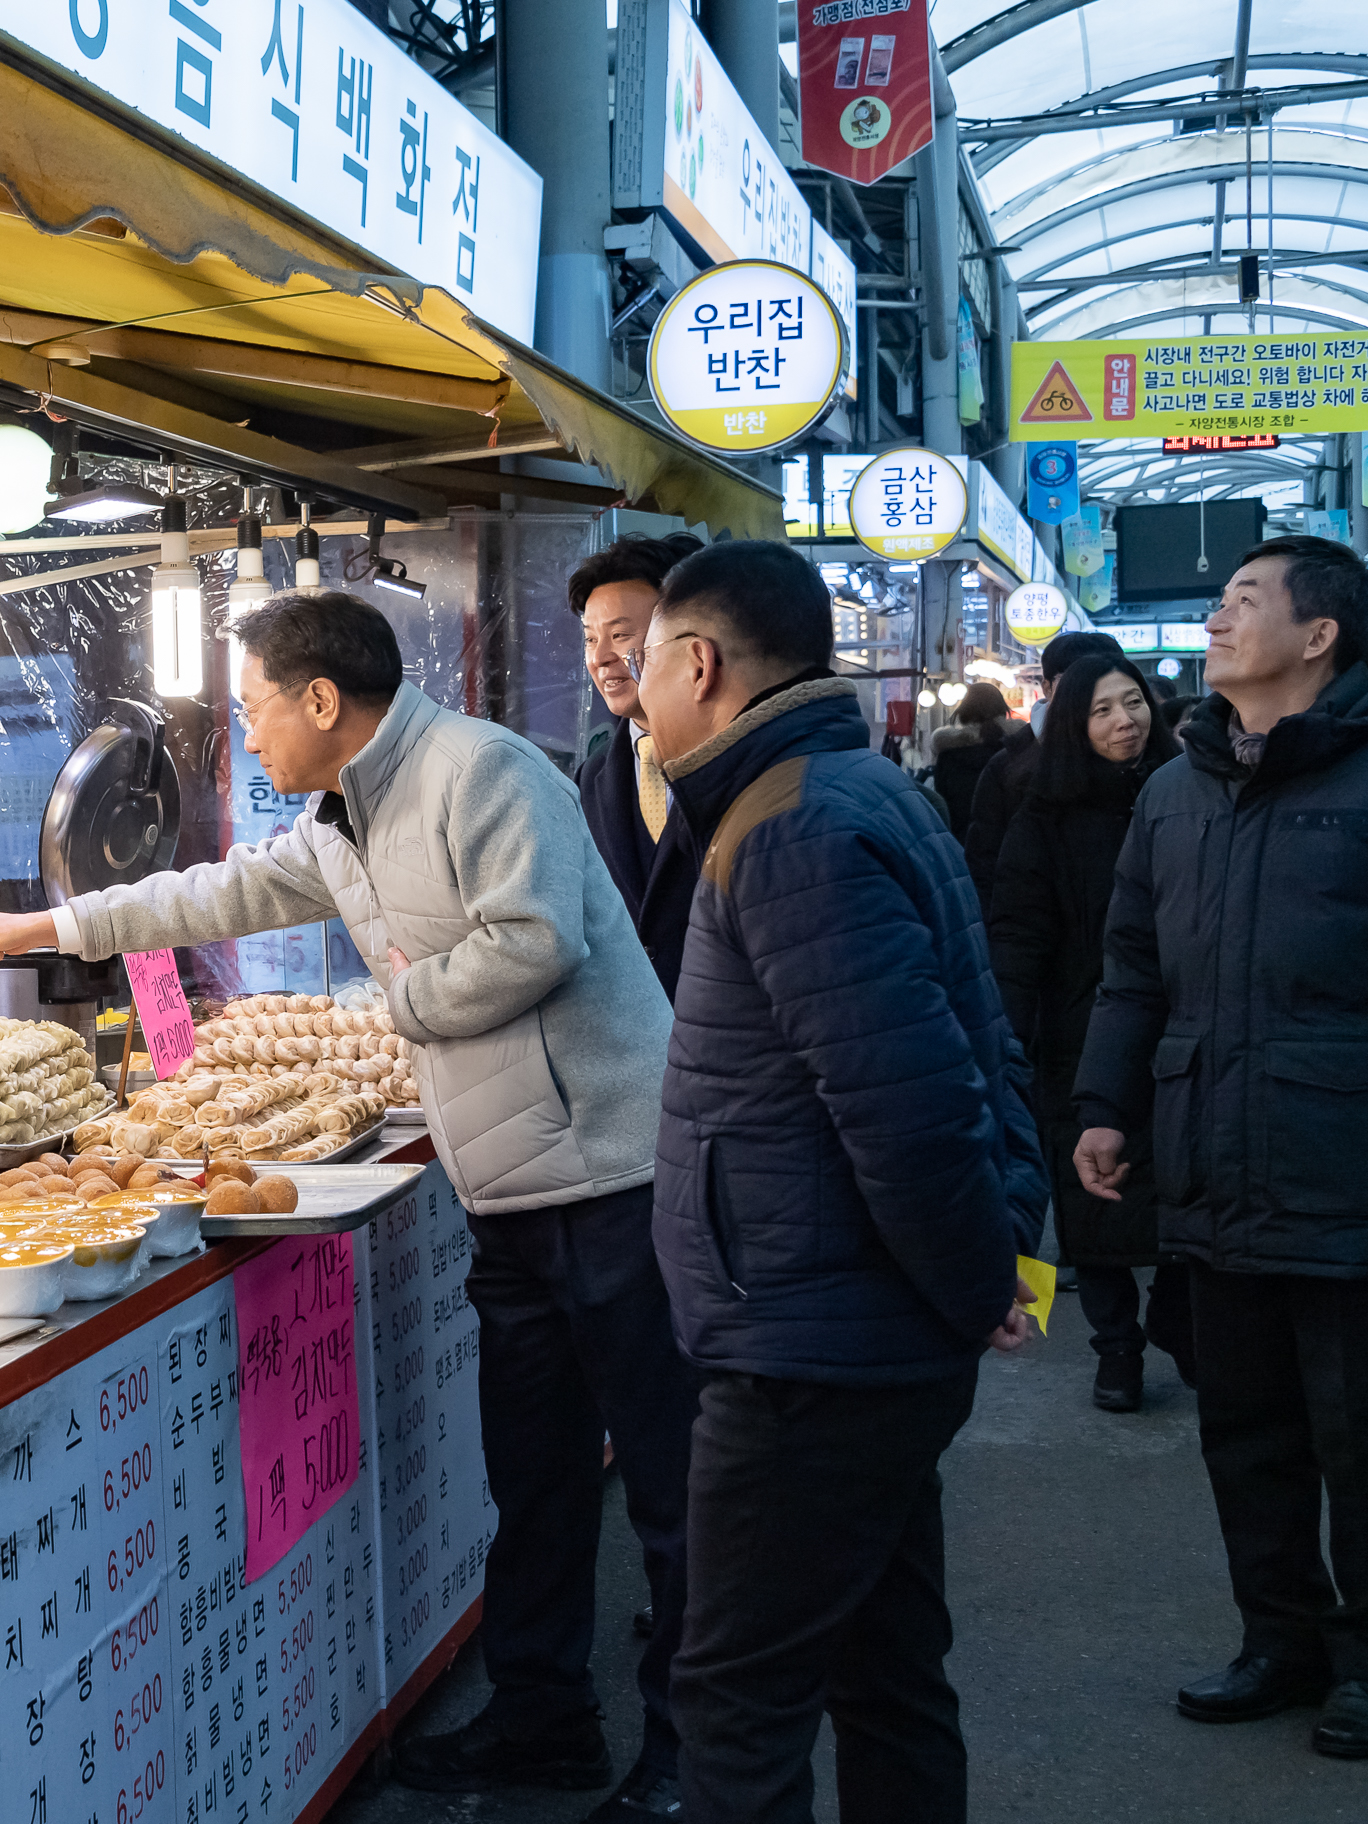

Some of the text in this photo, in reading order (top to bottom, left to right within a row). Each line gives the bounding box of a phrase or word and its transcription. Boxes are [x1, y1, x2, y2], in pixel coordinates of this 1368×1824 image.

[687, 295, 806, 346] 우리집
[706, 347, 787, 393] 반찬
[1143, 345, 1192, 366] 시장내
[1198, 343, 1247, 364] 전구간
[1252, 341, 1317, 362] 오토바이
[1143, 368, 1176, 390] 끌고
[1182, 367, 1252, 389] 다니세요!
[1257, 366, 1290, 386] 위험
[1296, 364, 1345, 384] 합니다
[1109, 357, 1131, 417] 안내문
[1142, 391, 1207, 413] 사고나면
[1212, 390, 1246, 411] 도로
[1250, 388, 1317, 410] 교통법상
[1322, 387, 1354, 407] 차에
[722, 410, 768, 437] 반찬
[1188, 414, 1295, 430] 자양전통시장 조합
[880, 465, 937, 496] 금산
[1046, 460, 1057, 475] 3
[880, 497, 937, 528] 홍삼
[882, 536, 936, 553] 원액제조
[1010, 607, 1062, 622] 토종한우
[1023, 592, 1049, 607] 양평
[387, 1196, 418, 1242] 5,500
[389, 1246, 421, 1293] 5,000
[392, 1296, 423, 1344] 5,000
[291, 1318, 353, 1421] 김치만두
[395, 1345, 425, 1394] 5,000
[99, 1365, 150, 1434] 6,500
[103, 1442, 153, 1513] 6,500
[396, 1444, 427, 1497] 3,000
[397, 1493, 428, 1546] 3,000
[107, 1518, 156, 1593] 6,500
[399, 1542, 429, 1597] 3,000
[278, 1553, 313, 1616] 5,500
[110, 1595, 160, 1673] 6,500
[280, 1609, 314, 1674] 5,500
[401, 1591, 430, 1648] 3,000
[113, 1672, 163, 1753] 6,500
[282, 1665, 316, 1733] 5,500
[283, 1722, 318, 1791] 5,000
